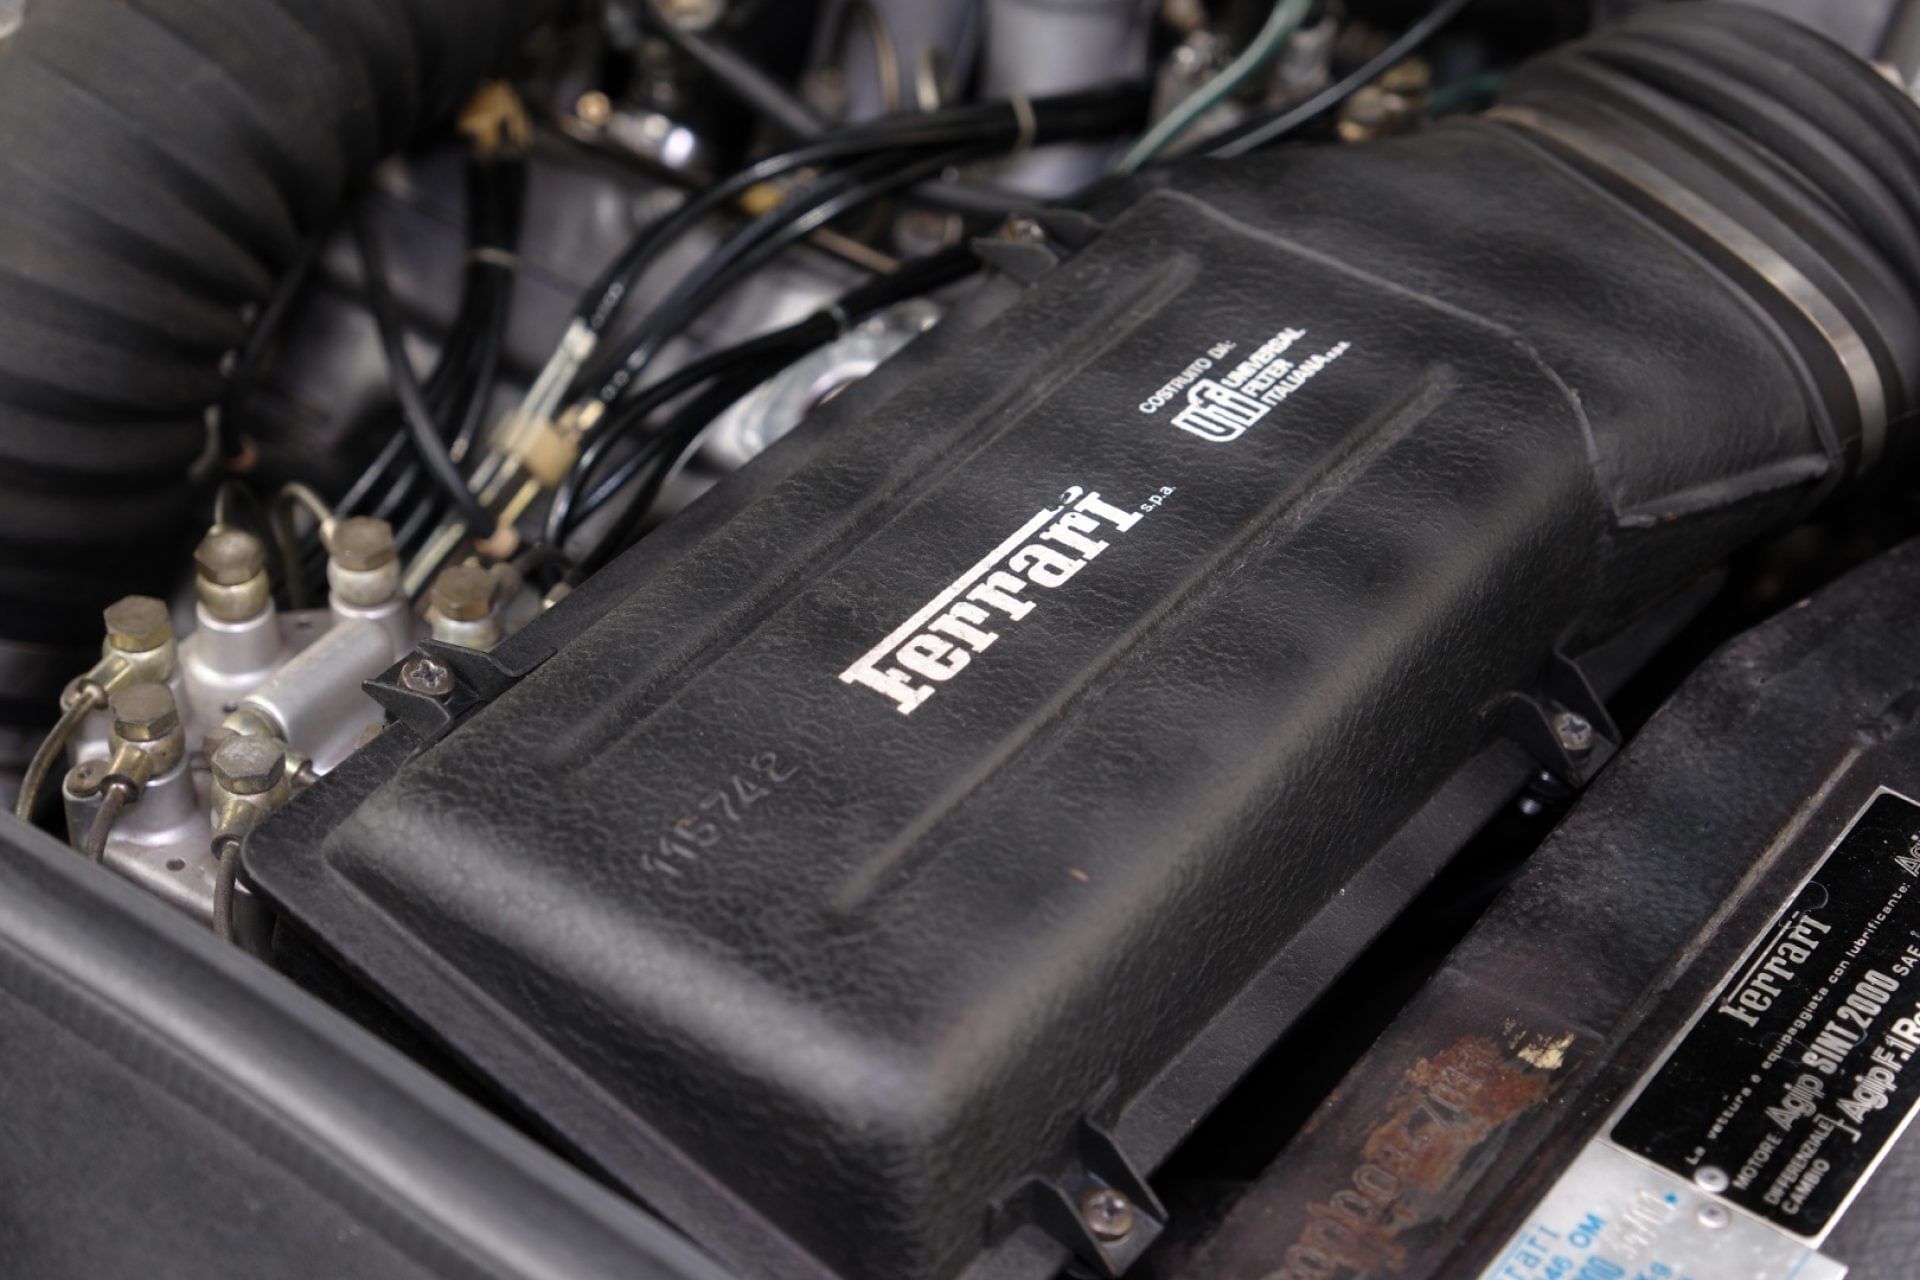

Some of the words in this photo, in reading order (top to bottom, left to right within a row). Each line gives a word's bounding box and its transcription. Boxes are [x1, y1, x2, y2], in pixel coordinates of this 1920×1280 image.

[1138, 357, 1213, 414] COSTRUITO
[1220, 326, 1307, 388] UNIVERSAL
[1241, 358, 1295, 397] FILTER
[838, 485, 1145, 716] Ferrari
[1139, 484, 1177, 513] s.p.a.
[1706, 1086, 1752, 1140] vettura
[1761, 986, 1830, 1070] equipaggiata
[1828, 959, 1850, 984] con
[1846, 882, 1912, 957] lubrificante:
[1718, 910, 1832, 1028] Ferrari
[1764, 1073, 1826, 1132] Agip
[1801, 1020, 1860, 1075] SINT
[1856, 968, 1900, 1029] 2000
[1892, 943, 1920, 977] SAE
[1762, 1118, 1835, 1206] DIFFERENZIALE
[1835, 1066, 1899, 1124] Agip
[1781, 1158, 1831, 1215] CAMBIO
